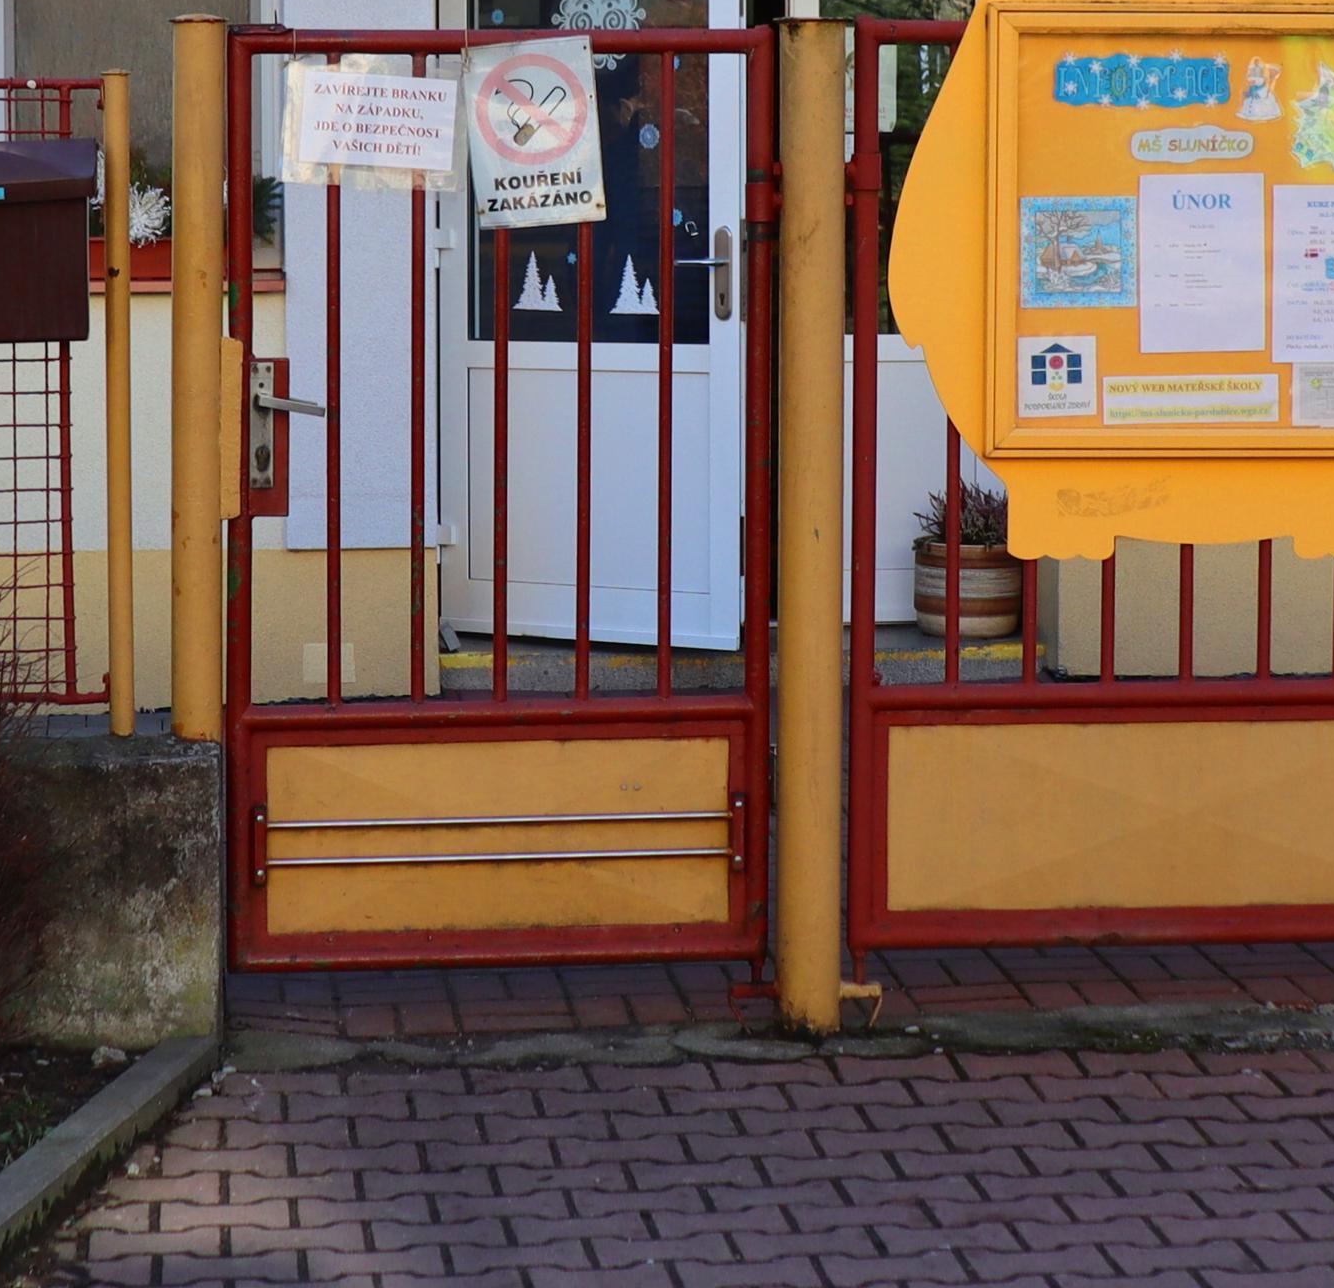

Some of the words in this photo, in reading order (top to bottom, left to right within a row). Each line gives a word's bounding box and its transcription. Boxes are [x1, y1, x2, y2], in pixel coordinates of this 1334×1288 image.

[314, 83, 388, 98] ZAVÍREJTE
[392, 87, 447, 102] BRANKU
[335, 103, 353, 114] NA
[357, 102, 424, 120] ZÁPADKU,
[314, 121, 338, 132] JDE
[342, 122, 352, 132] O
[355, 123, 442, 139] BEZPEČNOST
[332, 139, 382, 153] VAŠICH
[385, 141, 421, 156] DĚTÍ!
[1137, 135, 1162, 152] MŠ
[1168, 133, 1249, 152] SLUNÍČKO
[494, 167, 582, 191] KOUŘENÍ
[487, 190, 593, 212] ZAKÁZÁNO
[1172, 189, 1232, 210] ÚNOR
[1109, 382, 1140, 393] NOVÝ
[1141, 383, 1165, 393] WEB
[1167, 381, 1225, 392] MATEŘSKÉ
[1227, 380, 1262, 392] ŠKOLY
